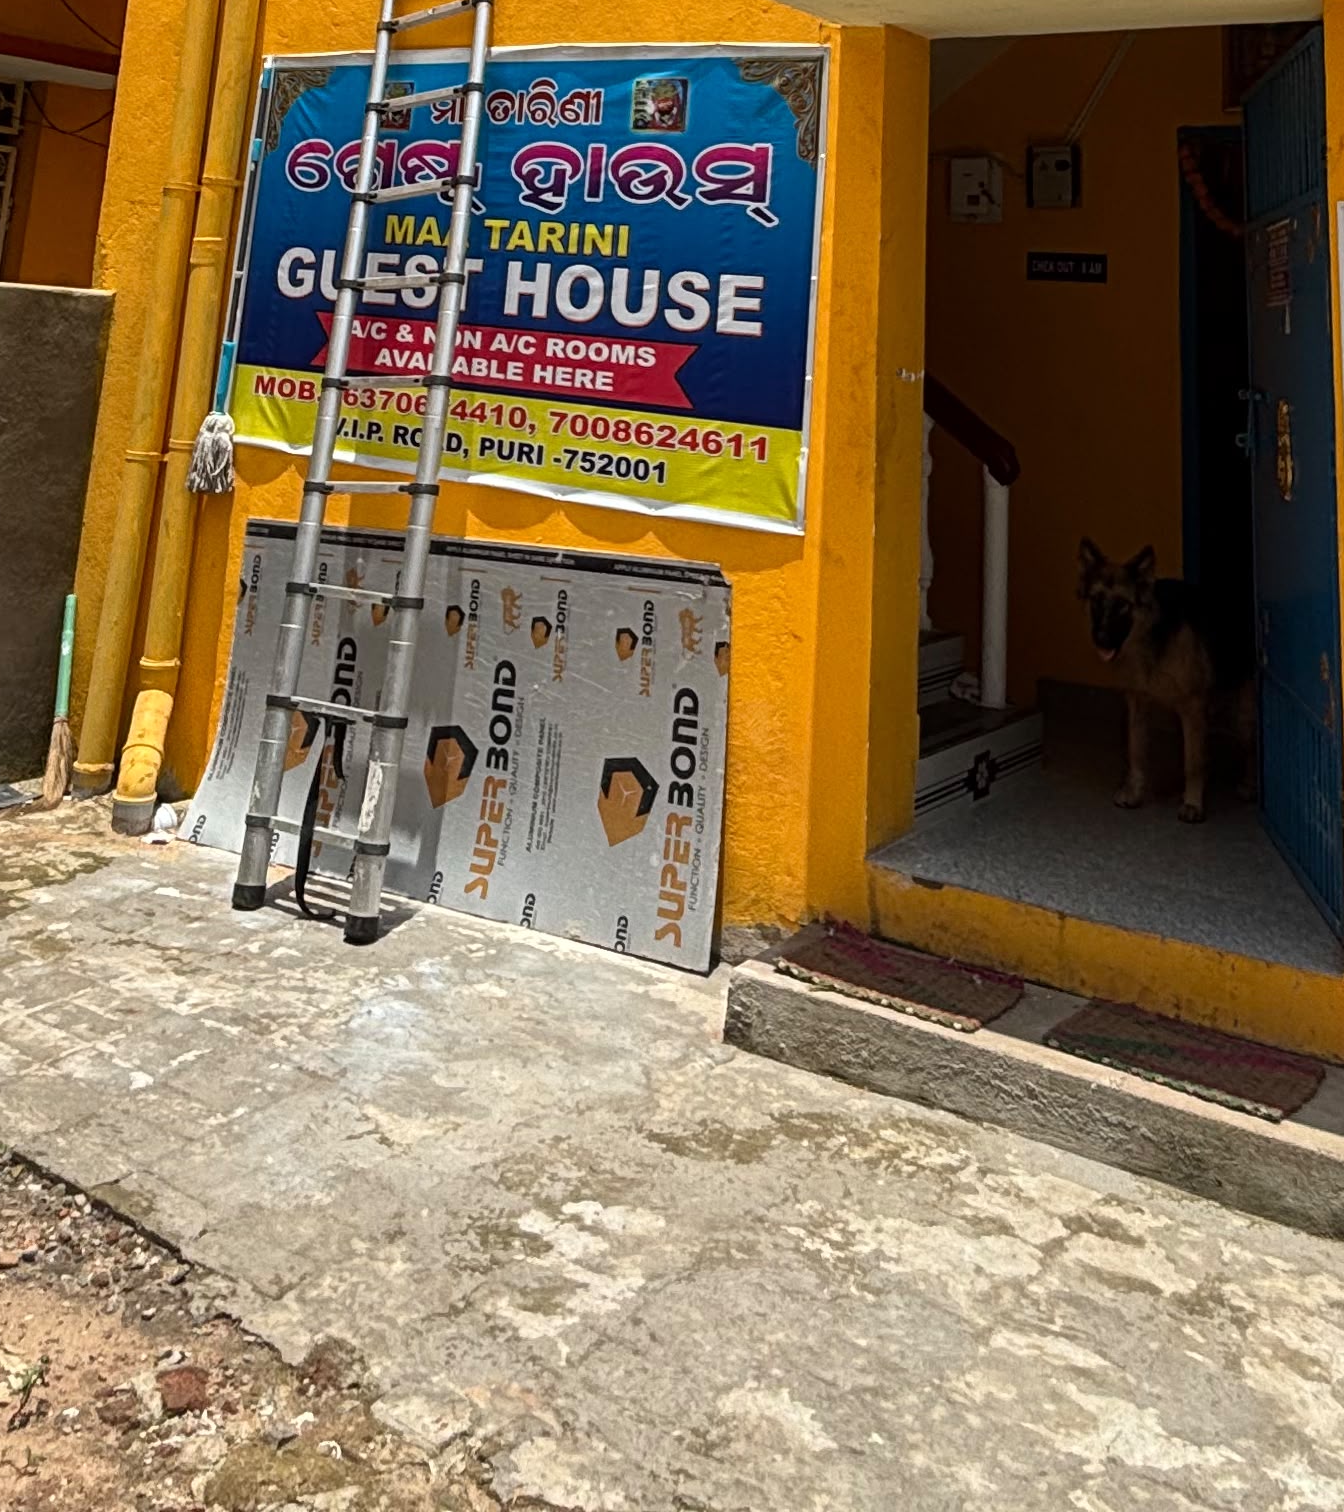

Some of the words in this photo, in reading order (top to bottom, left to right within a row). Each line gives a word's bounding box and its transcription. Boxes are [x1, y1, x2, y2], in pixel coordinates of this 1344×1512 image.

[486, 78, 605, 128] ତାରିଣୀ
[511, 141, 779, 227] ହାଉସ୍
[484, 219, 630, 258] TARINI
[503, 260, 765, 337] HOUSE
[351, 319, 387, 340] A/C
[395, 323, 414, 343] &
[424, 326, 482, 350] NN
[489, 332, 537, 356] A/C
[546, 338, 657, 368] ROOMS
[374, 347, 524, 381] AVAIABLE
[533, 364, 615, 392] HERE
[342, 387, 536, 435] 637064410,
[548, 410, 768, 462] 7008624611
[393, 425, 469, 458] ROD,
[479, 436, 544, 466] PURI
[553, 448, 667, 484] -752001
[698, 727, 709, 772] DESIGN
[497, 807, 513, 866] FUNCTION
[514, 696, 525, 739] DESIGN
[695, 785, 706, 835] QUALITY
[688, 848, 701, 912] FUNCTION
